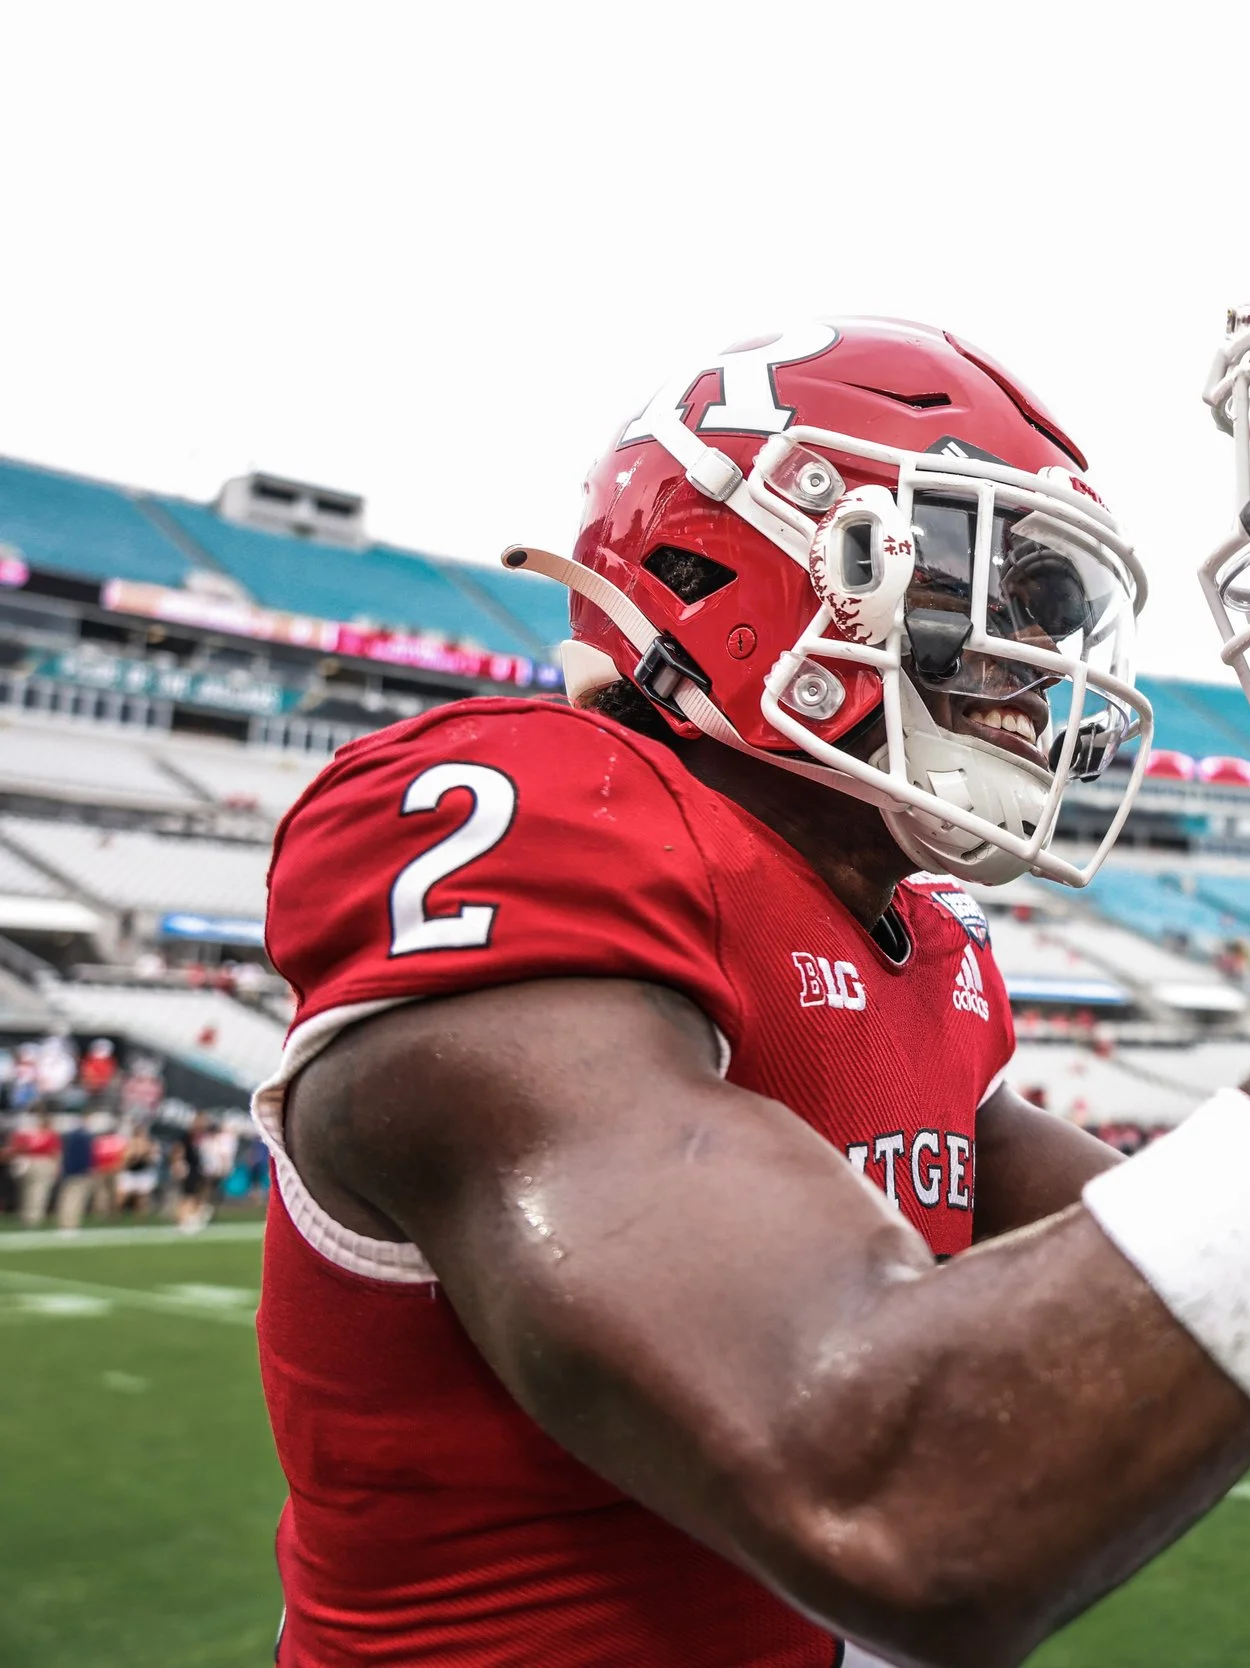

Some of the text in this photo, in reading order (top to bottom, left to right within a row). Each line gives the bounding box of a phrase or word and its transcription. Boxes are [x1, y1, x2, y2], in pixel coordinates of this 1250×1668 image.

[388, 759, 520, 960] 2
[953, 990, 989, 1022] adidas
[846, 1127, 976, 1213] TGE
